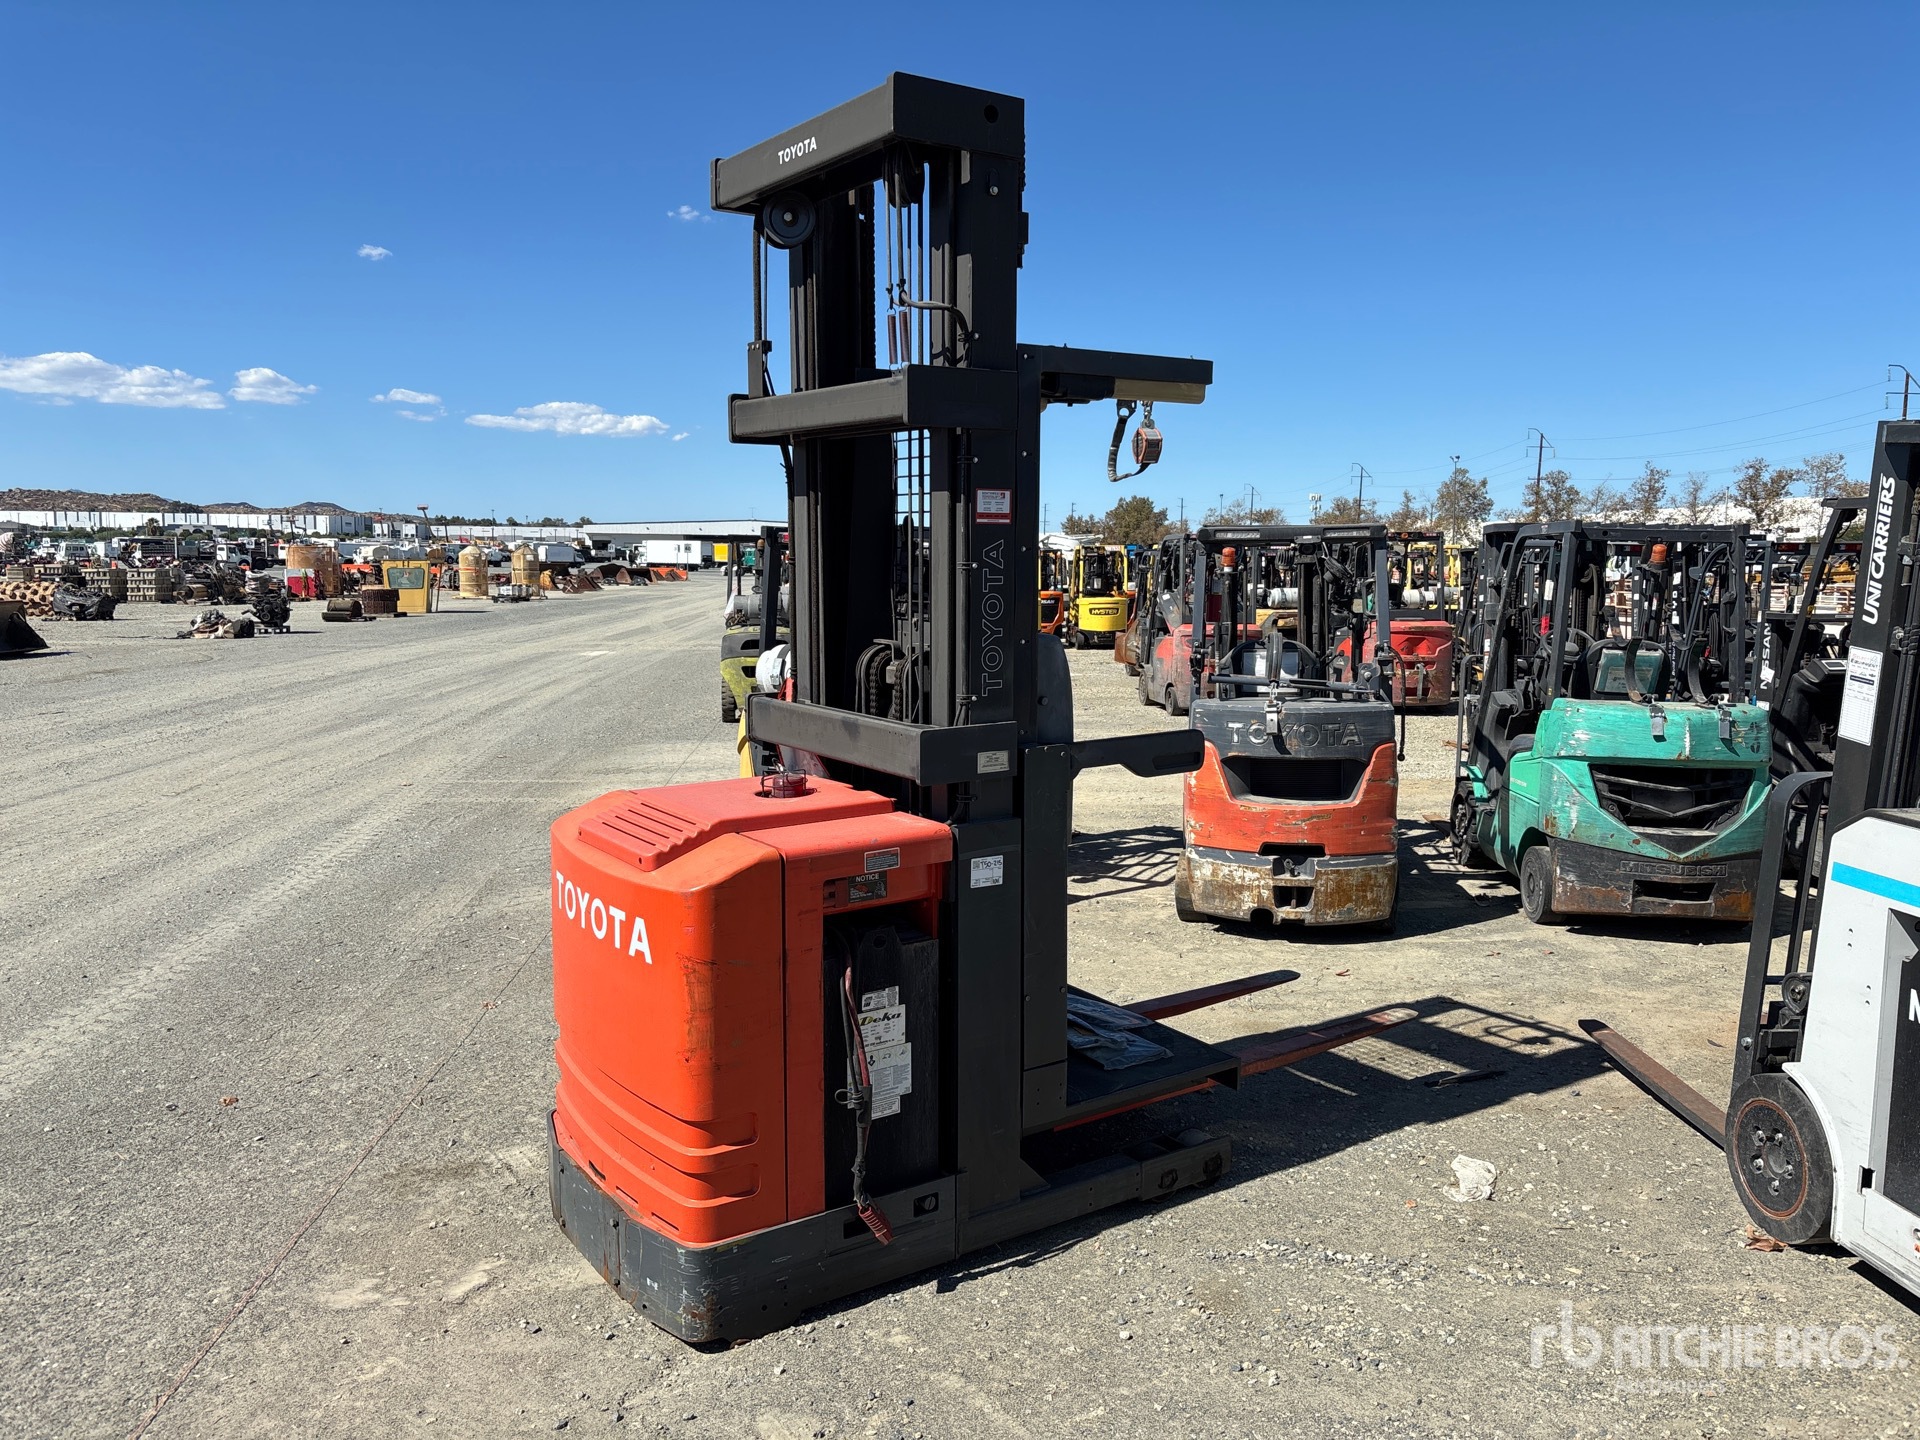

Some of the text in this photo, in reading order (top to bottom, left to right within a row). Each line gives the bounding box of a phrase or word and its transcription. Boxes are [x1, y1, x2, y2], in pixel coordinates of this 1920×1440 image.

[778, 136, 817, 165] TOYOTA
[981, 539, 1004, 697] TOYOTA
[1760, 623, 1772, 690] NSSAN
[1226, 721, 1364, 747] TOYOTA
[855, 872, 880, 883] NOTICE
[556, 869, 653, 965] TOYOTA
[859, 1012, 902, 1026] Deka
